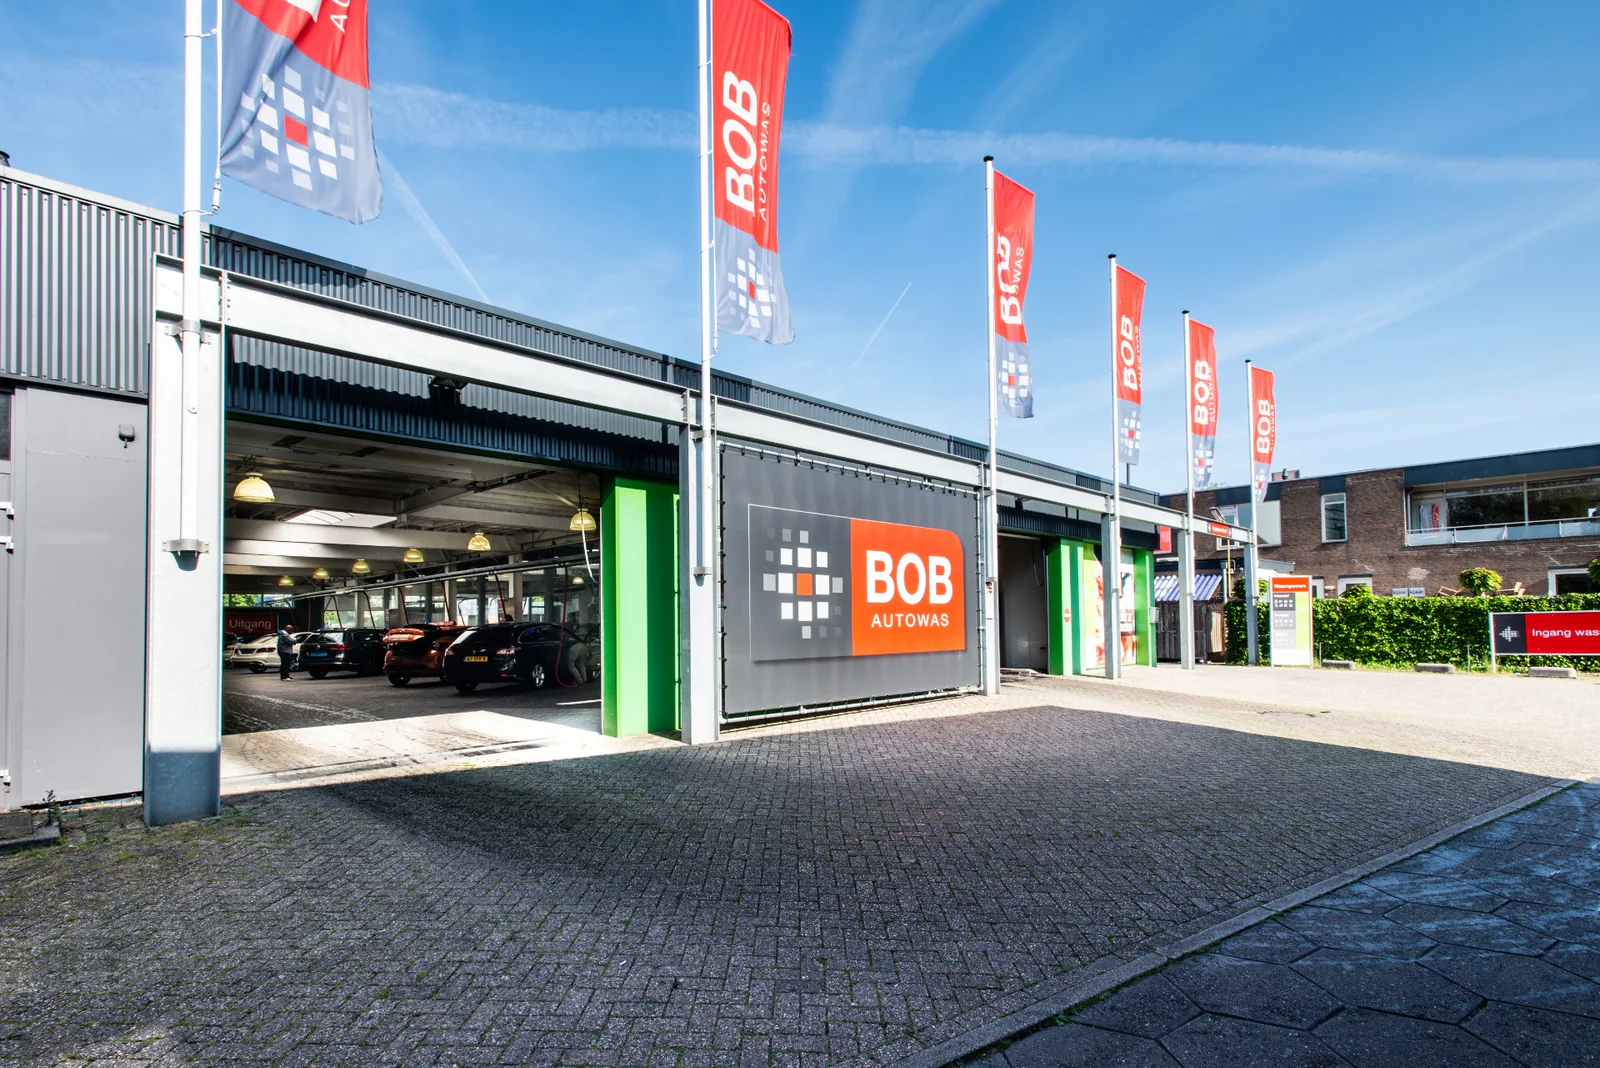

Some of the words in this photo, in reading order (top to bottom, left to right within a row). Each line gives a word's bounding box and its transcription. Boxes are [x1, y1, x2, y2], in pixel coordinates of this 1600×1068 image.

[723, 71, 758, 217] BOB
[759, 102, 771, 222] AUTOWAS
[1120, 314, 1139, 391] BOB
[1194, 360, 1210, 425] BOB
[1256, 399, 1271, 454] BOB
[866, 549, 954, 605] BOB
[229, 619, 272, 630] Uitgang
[871, 613, 950, 628] AUTOWAS
[1531, 628, 1572, 639] Ingang
[1575, 629, 1600, 637] was
